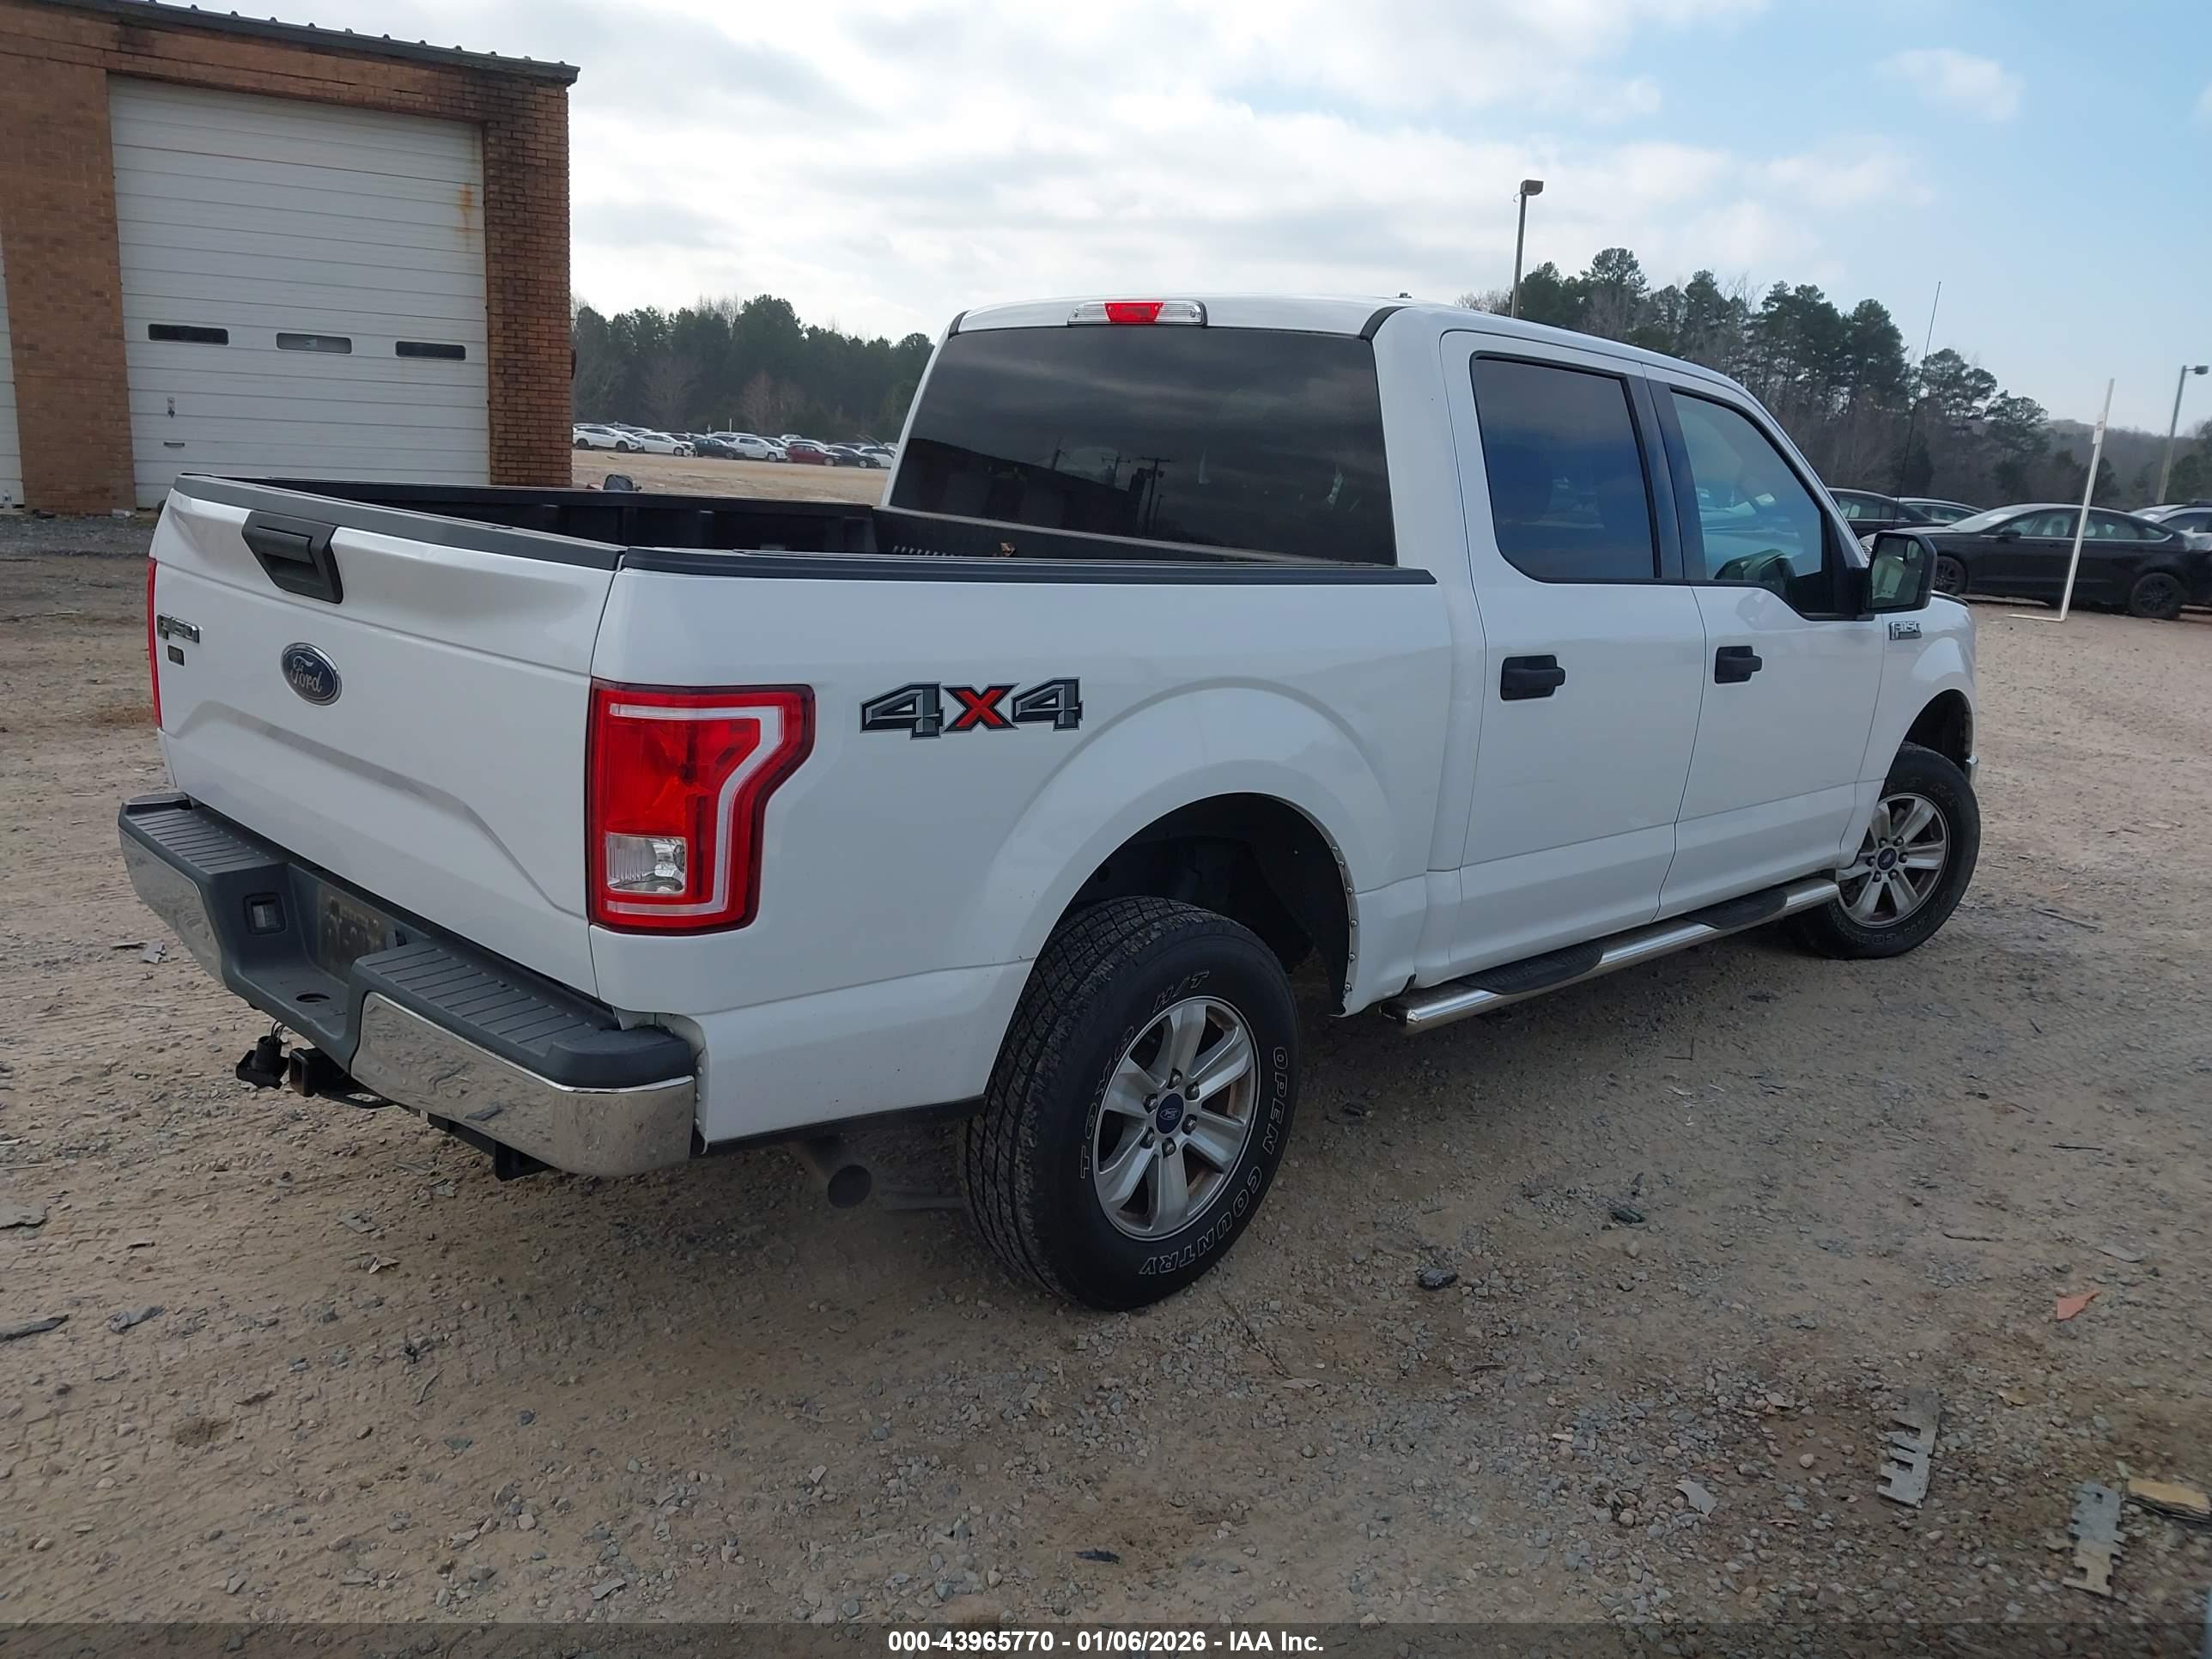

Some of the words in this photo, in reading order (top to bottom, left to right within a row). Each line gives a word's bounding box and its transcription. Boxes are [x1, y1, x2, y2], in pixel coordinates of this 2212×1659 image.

[289, 655, 323, 693] Ford
[1079, 1025, 1134, 1181] TOYO
[1262, 1046, 1290, 1155] OPEN
[1138, 1164, 1264, 1276] COUNTRY
